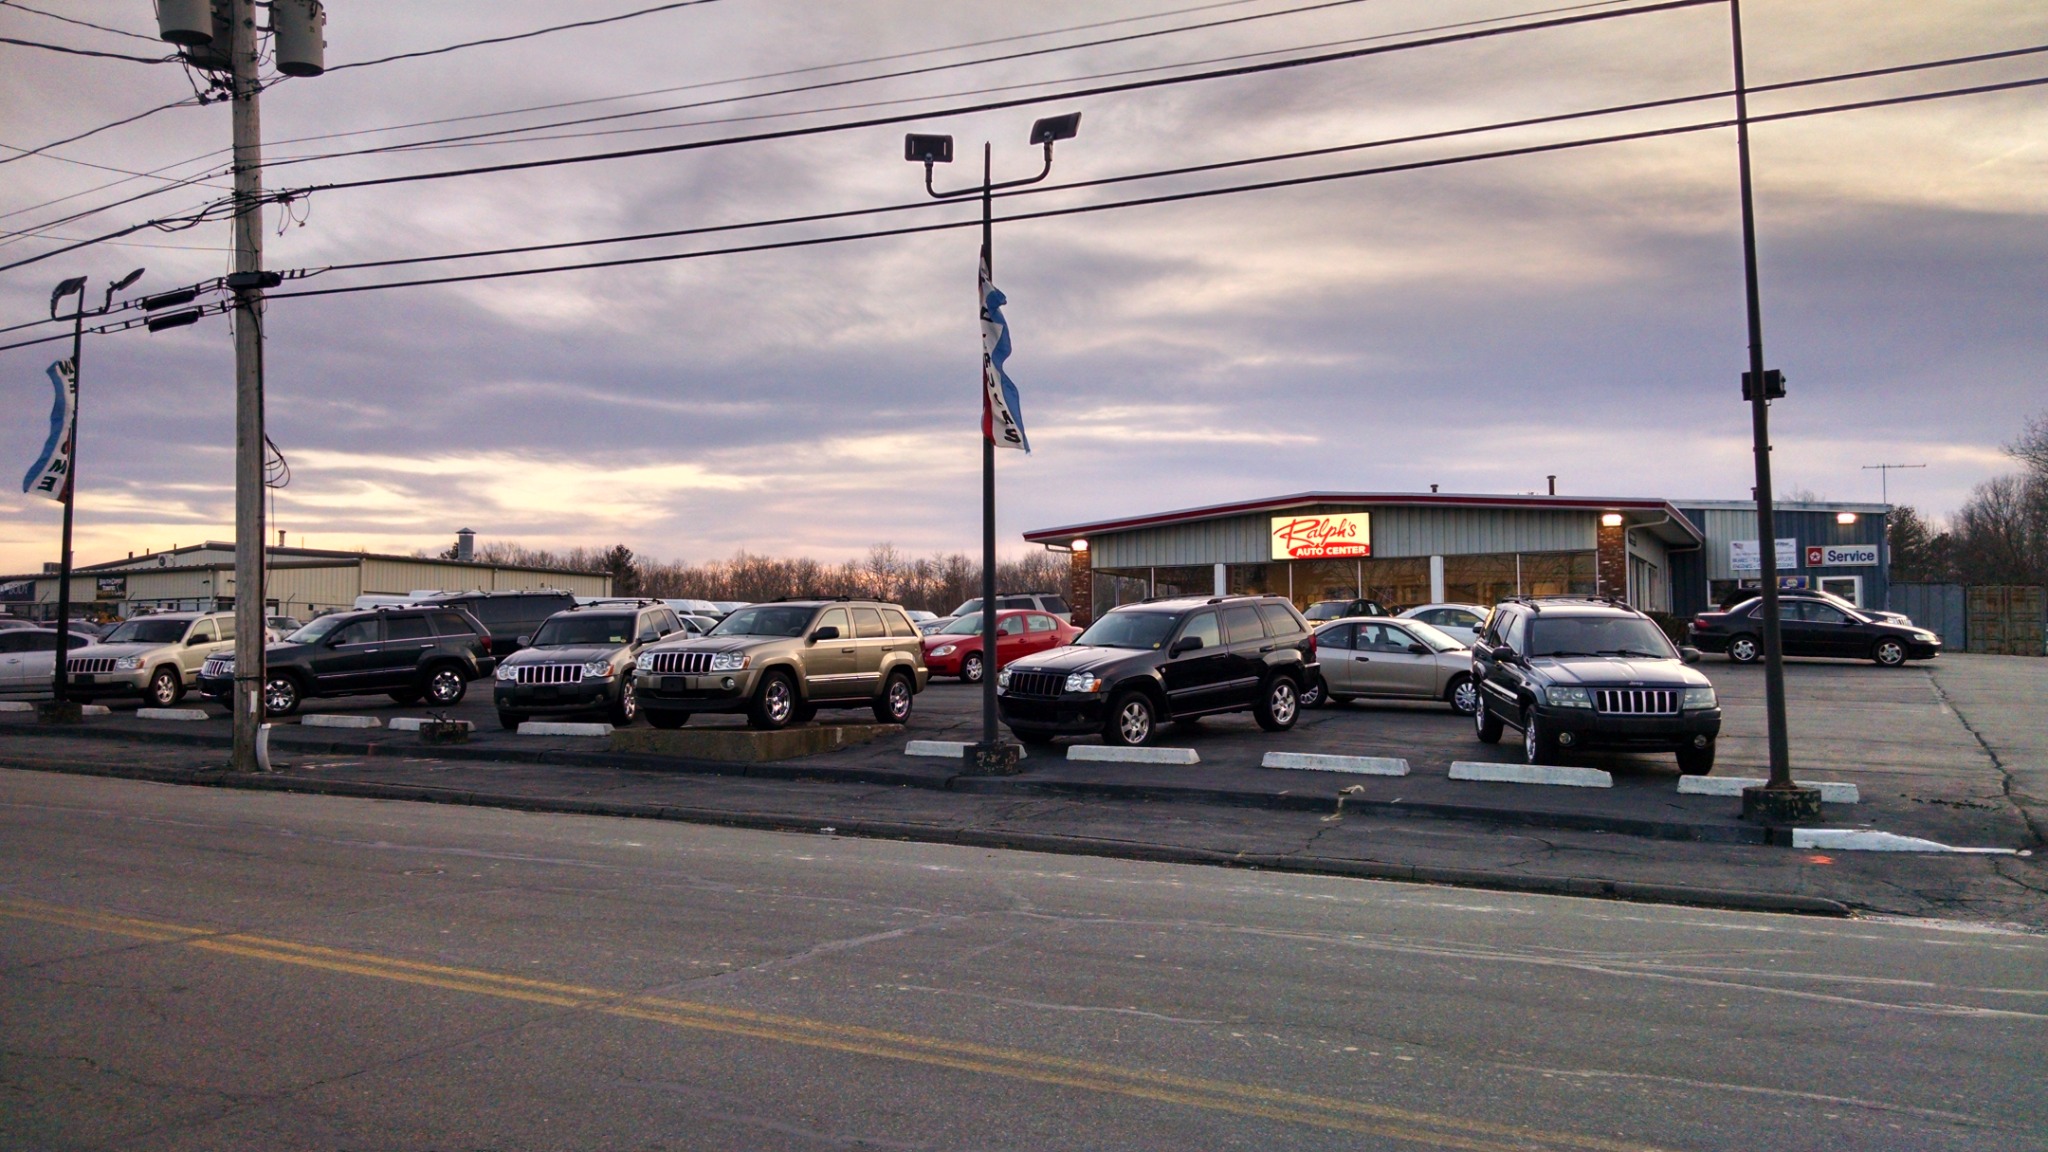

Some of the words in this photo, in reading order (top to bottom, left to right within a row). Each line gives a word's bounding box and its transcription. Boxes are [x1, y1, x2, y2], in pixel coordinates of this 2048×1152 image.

[1273, 518, 1357, 549] Ralph's
[1296, 546, 1324, 556] AUTO
[1326, 545, 1366, 555] CENTER
[1827, 550, 1875, 562] Service
